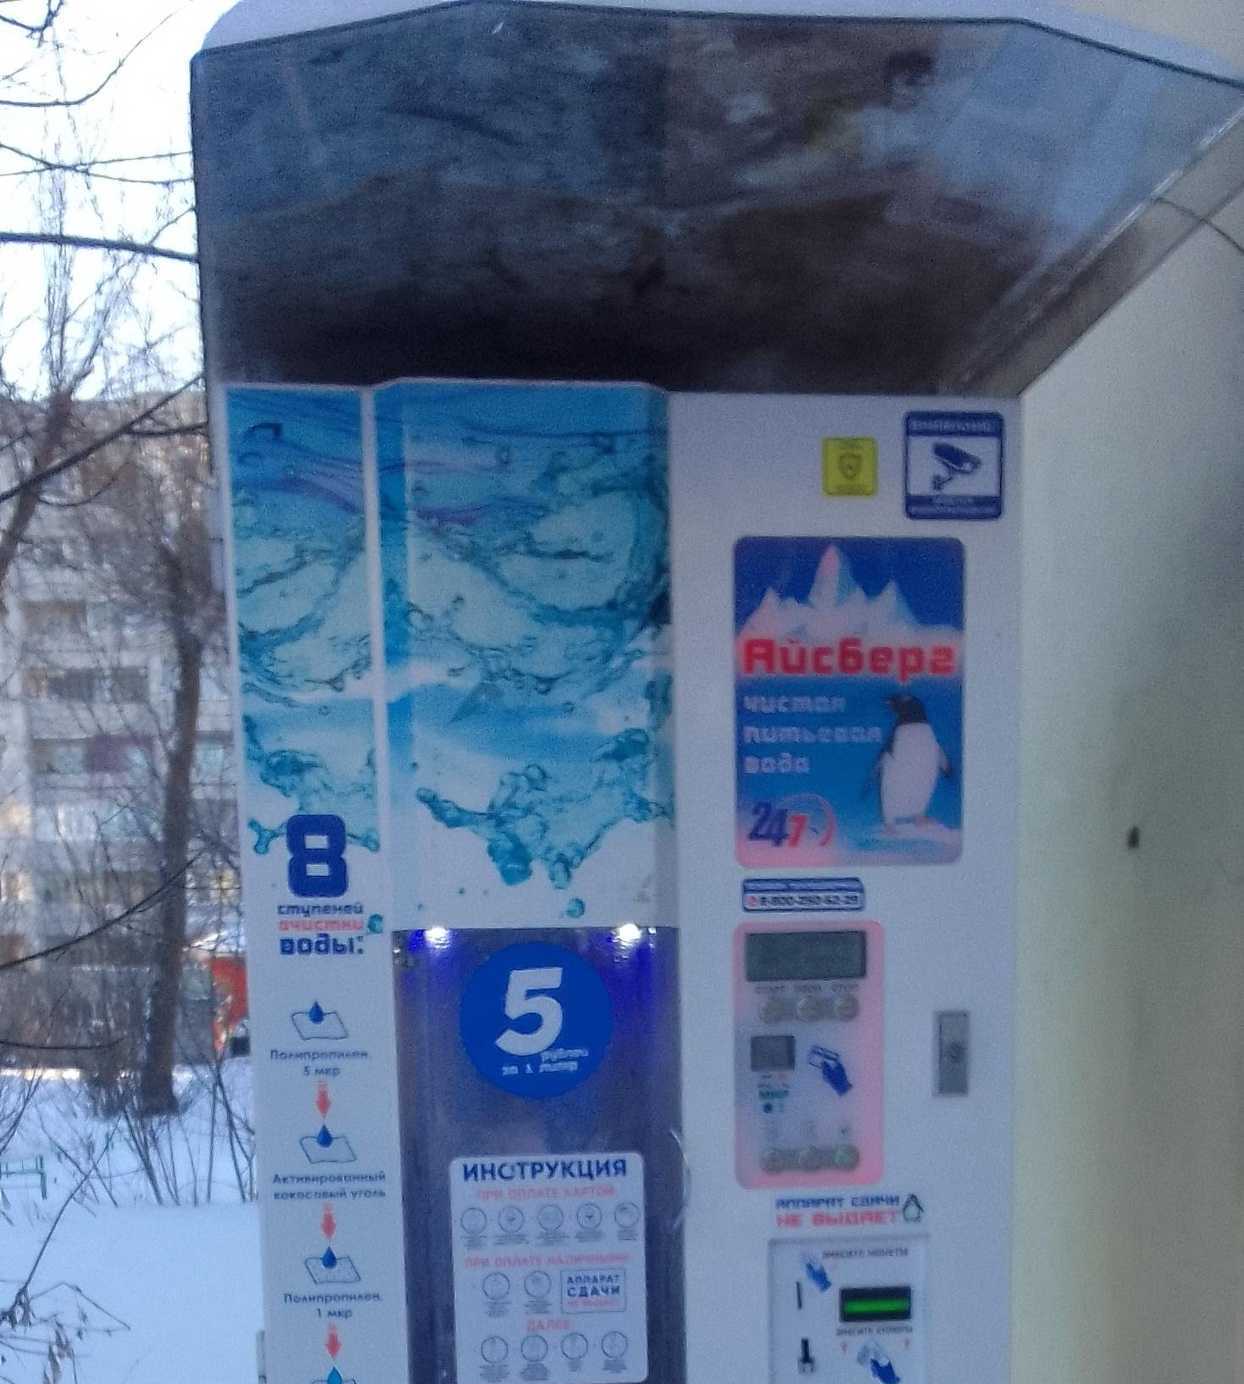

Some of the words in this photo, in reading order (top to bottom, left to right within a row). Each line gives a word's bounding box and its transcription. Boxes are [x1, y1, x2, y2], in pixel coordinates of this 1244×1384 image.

[743, 637, 955, 681] Айсберг
[743, 696, 845, 713] чистая
[743, 727, 882, 743] питьевая
[743, 753, 809, 774] вода
[286, 814, 349, 897] 8
[277, 902, 364, 917] ступеней
[279, 918, 364, 931] очистки
[280, 933, 364, 955] воды:
[495, 966, 563, 1056] 5
[304, 1066, 311, 1076] 5
[463, 1159, 627, 1182] ИНСТРУКЦИЯ
[273, 1172, 385, 1186] Активированный
[274, 1188, 347, 1200] кокосовый
[351, 1187, 386, 1199] уголь
[776, 1198, 844, 1210] АППАРАТ
[777, 1215, 802, 1228] НЕ
[567, 1275, 619, 1284] АППАРАТ
[567, 1286, 620, 1297] СДАЧИ
[317, 1308, 322, 1317] 1
